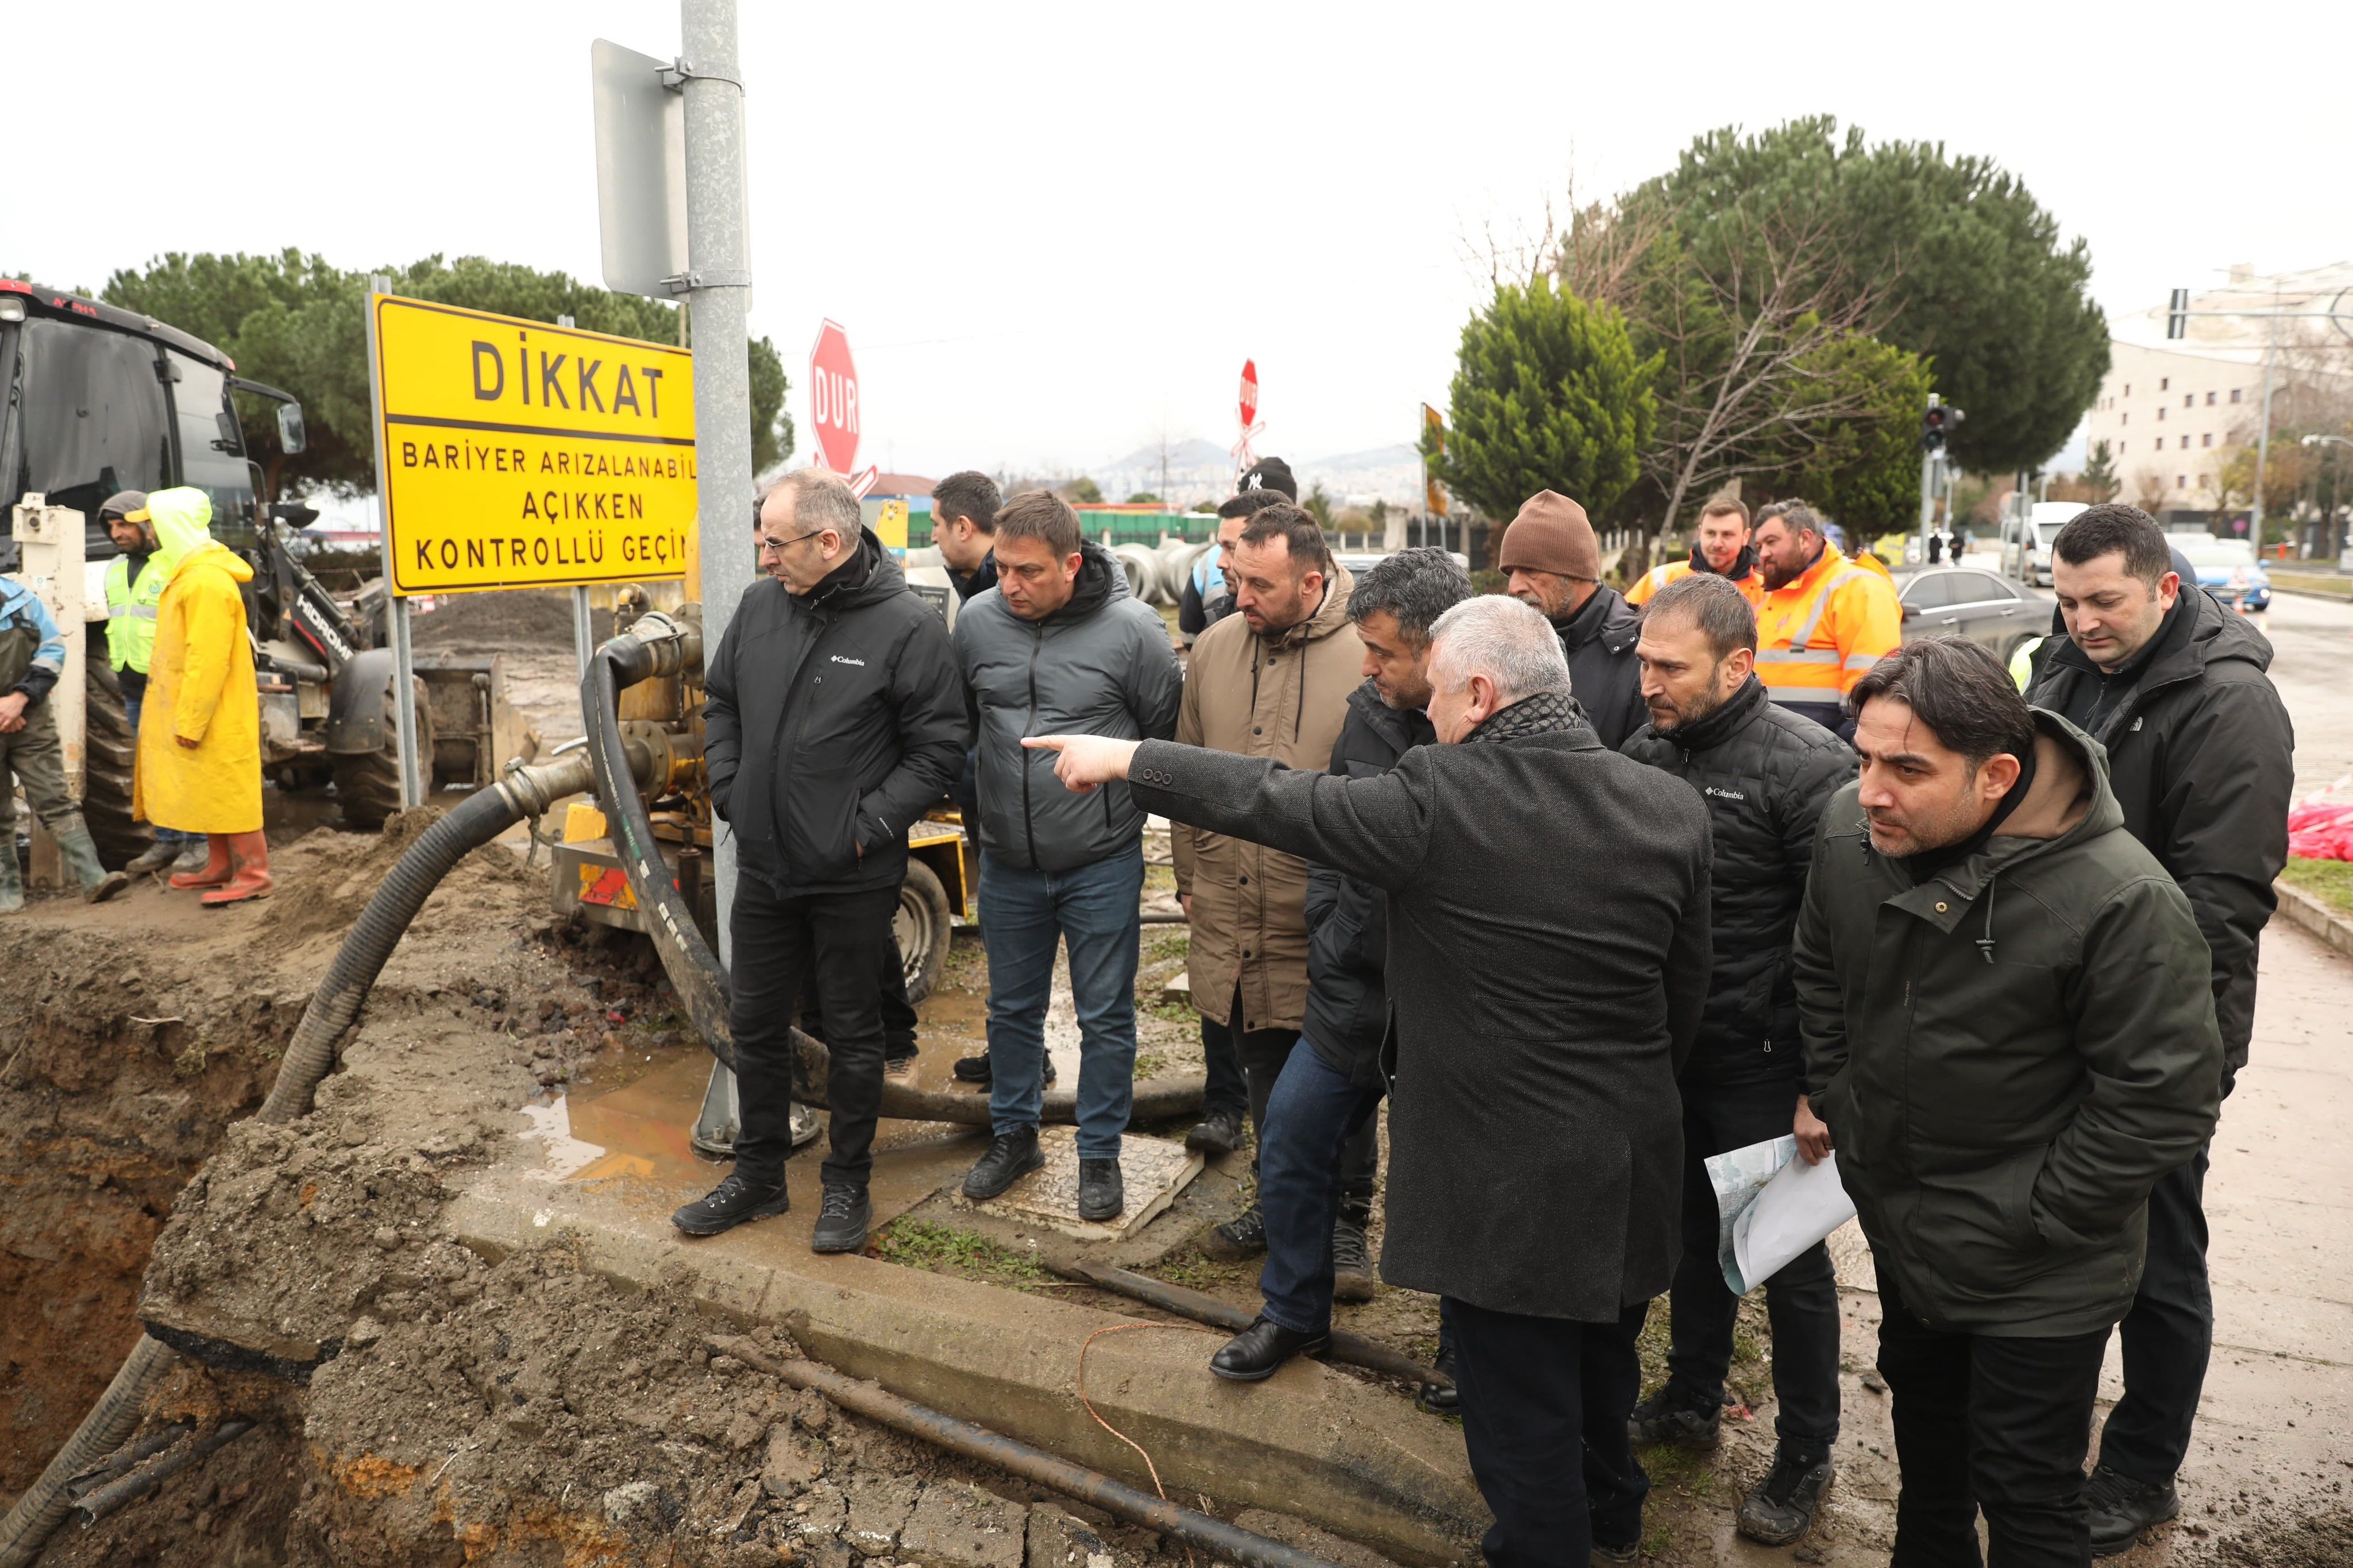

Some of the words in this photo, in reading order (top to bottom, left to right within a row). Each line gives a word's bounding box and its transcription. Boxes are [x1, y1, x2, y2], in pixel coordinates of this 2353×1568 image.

[52, 296, 98, 318] APHA
[472, 331, 663, 419] DİKKAT
[815, 365, 858, 435] DUR
[403, 439, 526, 473] BARİYER
[541, 451, 697, 480] ARIZALANABİL
[522, 491, 643, 524] AÇIKKEN
[416, 529, 603, 570] KONTROLLÜ
[837, 656, 865, 667] Columbia
[1713, 788, 1744, 800] Columbia
